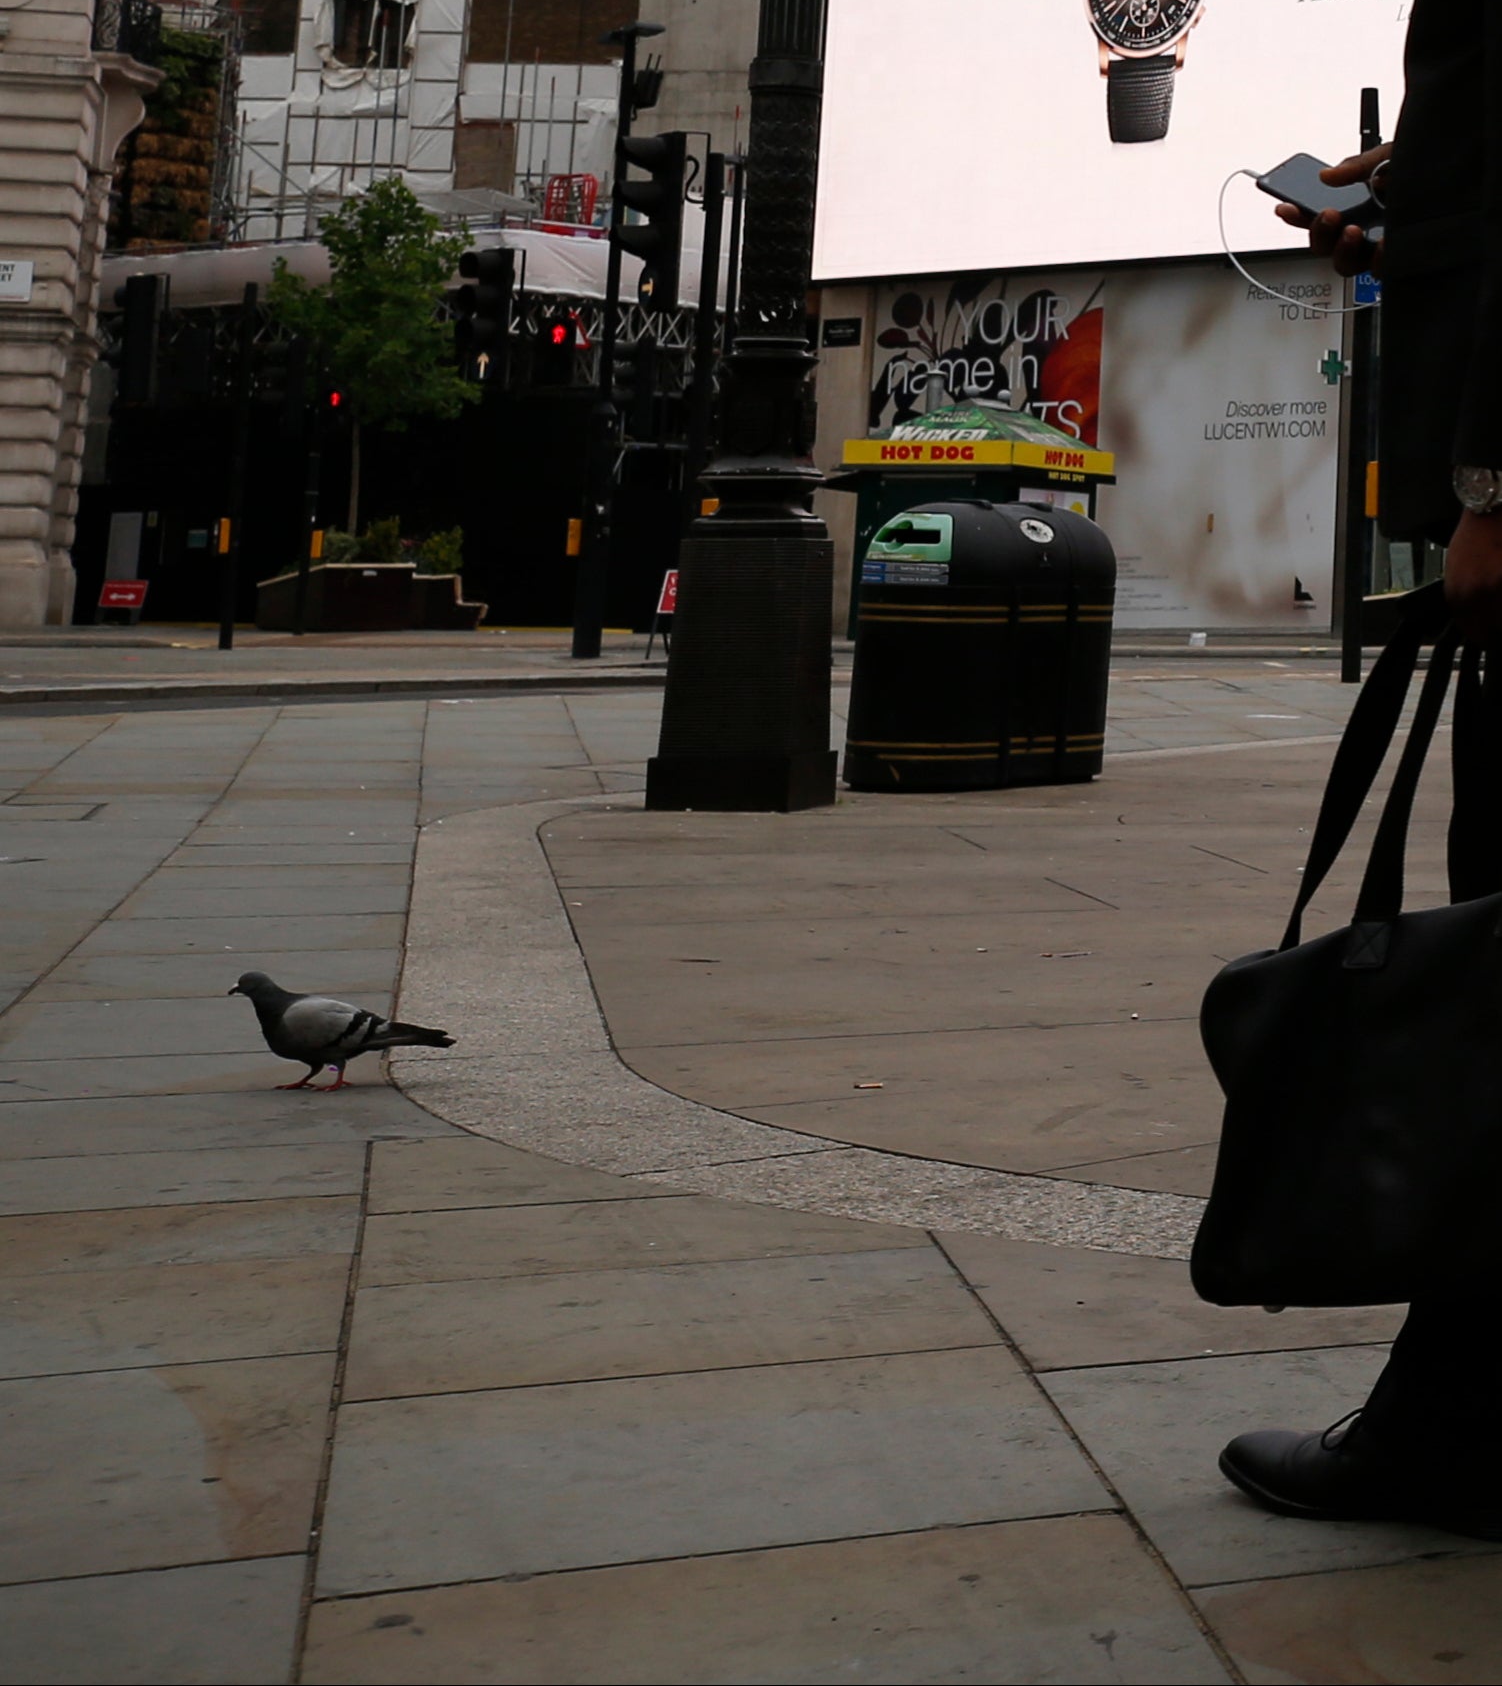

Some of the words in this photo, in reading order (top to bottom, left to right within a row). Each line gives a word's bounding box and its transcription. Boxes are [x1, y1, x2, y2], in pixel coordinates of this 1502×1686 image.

[1246, 283, 1286, 301] Retail
[1288, 283, 1333, 301] space
[954, 296, 1071, 345] YOUR
[1279, 303, 1300, 321] TO
[1303, 302, 1331, 320] LET
[888, 357, 995, 395] name
[1009, 345, 1038, 390] in
[1226, 400, 1287, 418] Discover
[1290, 400, 1328, 416] more
[1204, 420, 1326, 441] LUCENTW1.COM
[881, 445, 923, 460] HOT
[930, 445, 974, 460] DOG
[1044, 449, 1063, 466] HOT
[1065, 452, 1084, 468] DOG
